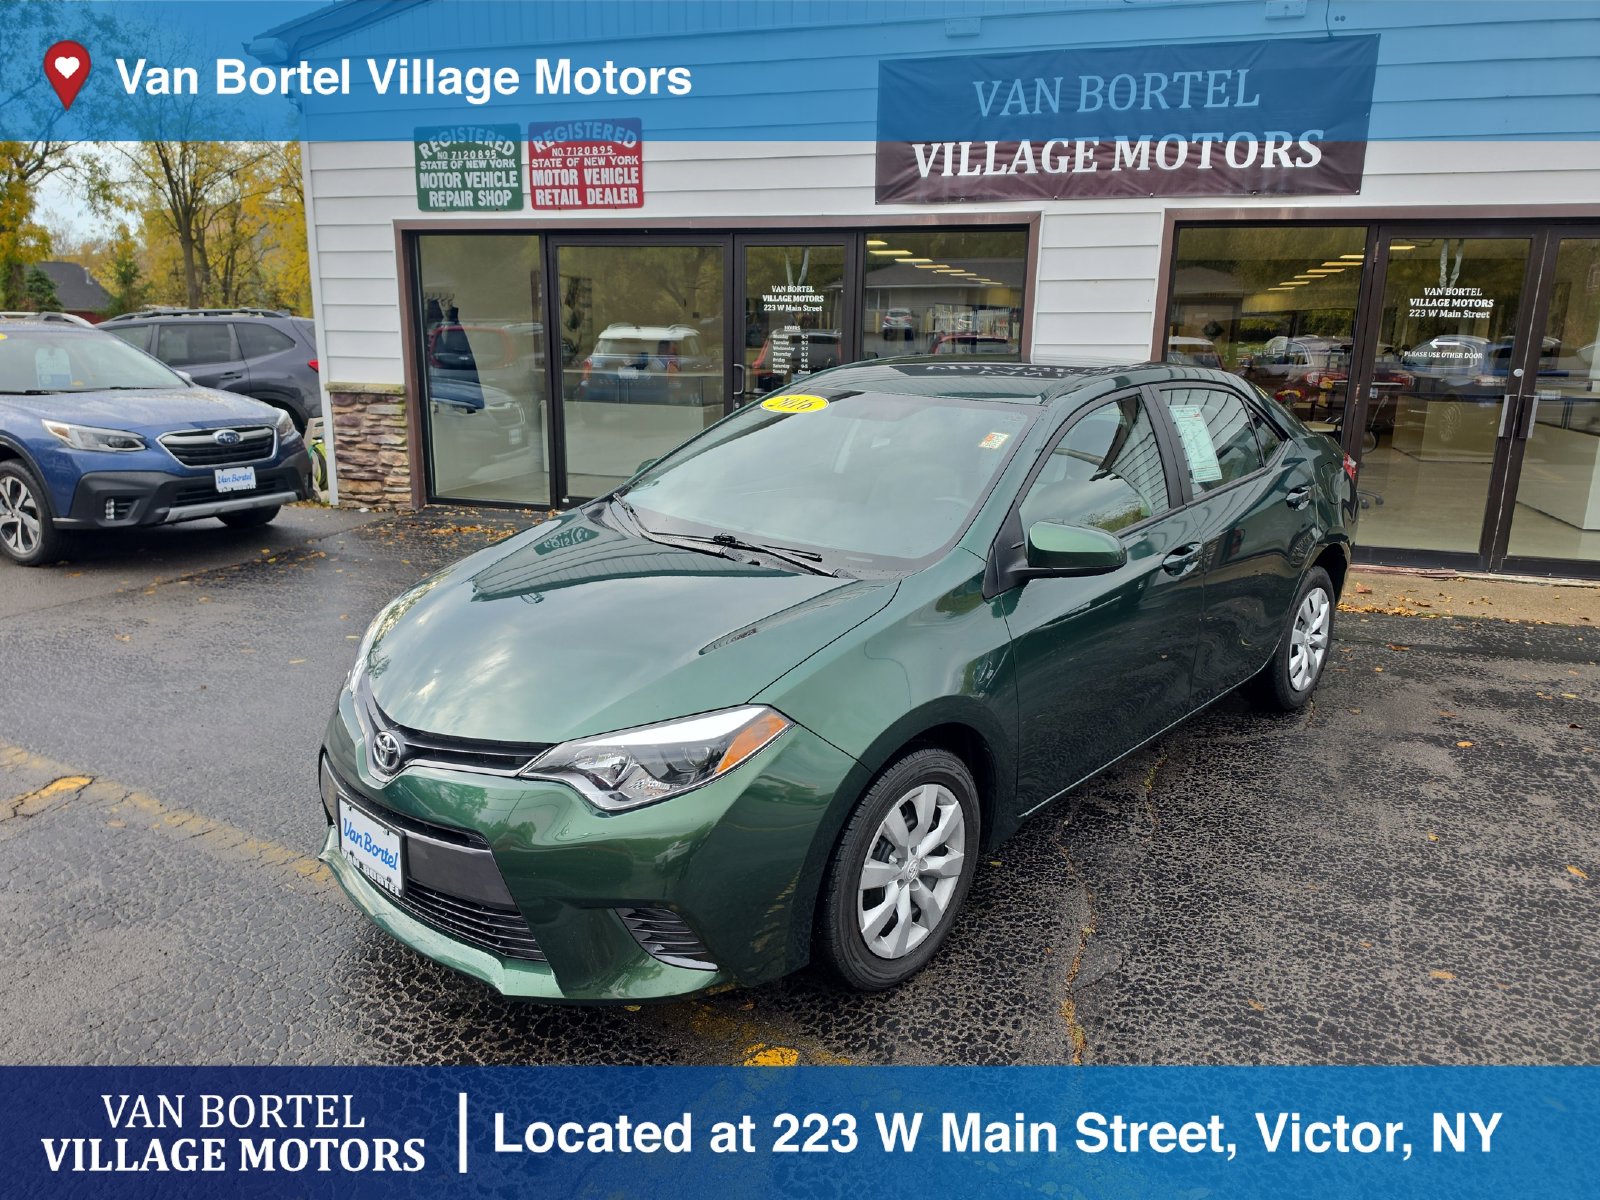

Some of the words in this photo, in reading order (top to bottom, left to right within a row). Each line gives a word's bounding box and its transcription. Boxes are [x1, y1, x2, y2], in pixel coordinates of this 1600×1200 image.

[973, 77, 1061, 117] VAN
[1077, 68, 1260, 112] BORTEL
[419, 126, 515, 159] REGISTERED
[531, 121, 638, 153] REGISTERED
[451, 150, 497, 160] 7120895
[567, 146, 613, 156] 7120895
[911, 138, 1100, 178] VILLAGE
[1112, 129, 1325, 171] MOTORS
[420, 160, 448, 170] STATE
[450, 160, 464, 169] OF
[466, 160, 487, 169] NEW
[489, 159, 516, 169] YORK
[532, 157, 562, 168] STATE
[567, 157, 580, 167] OF
[584, 156, 605, 166] NEW
[609, 155, 639, 165] YORK
[419, 171, 461, 189] MOTOR
[464, 170, 519, 188] VEHICLE
[532, 169, 578, 187] MOTOR
[584, 167, 640, 185] VEHICLE
[429, 190, 474, 207] REPAIR
[478, 189, 513, 207] SHOP
[535, 188, 582, 206] RETAIL
[587, 187, 638, 205] DEALER
[771, 285, 786, 293] VAN
[787, 285, 814, 293] BORTEL
[1424, 287, 1444, 296] VAN
[1445, 287, 1483, 296] BORTEL
[762, 294, 792, 302] VILLAGE
[1409, 298, 1450, 307] VILLAGE
[1451, 299, 1495, 308] MOTORS
[785, 304, 802, 312] Main
[1409, 309, 1426, 317] 223
[1428, 309, 1438, 317] W
[1439, 309, 1461, 318] Main
[1463, 310, 1490, 318] Street
[217, 475, 231, 484] Van
[231, 472, 253, 482] Bortel
[343, 817, 363, 849] Van
[363, 832, 399, 871] Bortel
